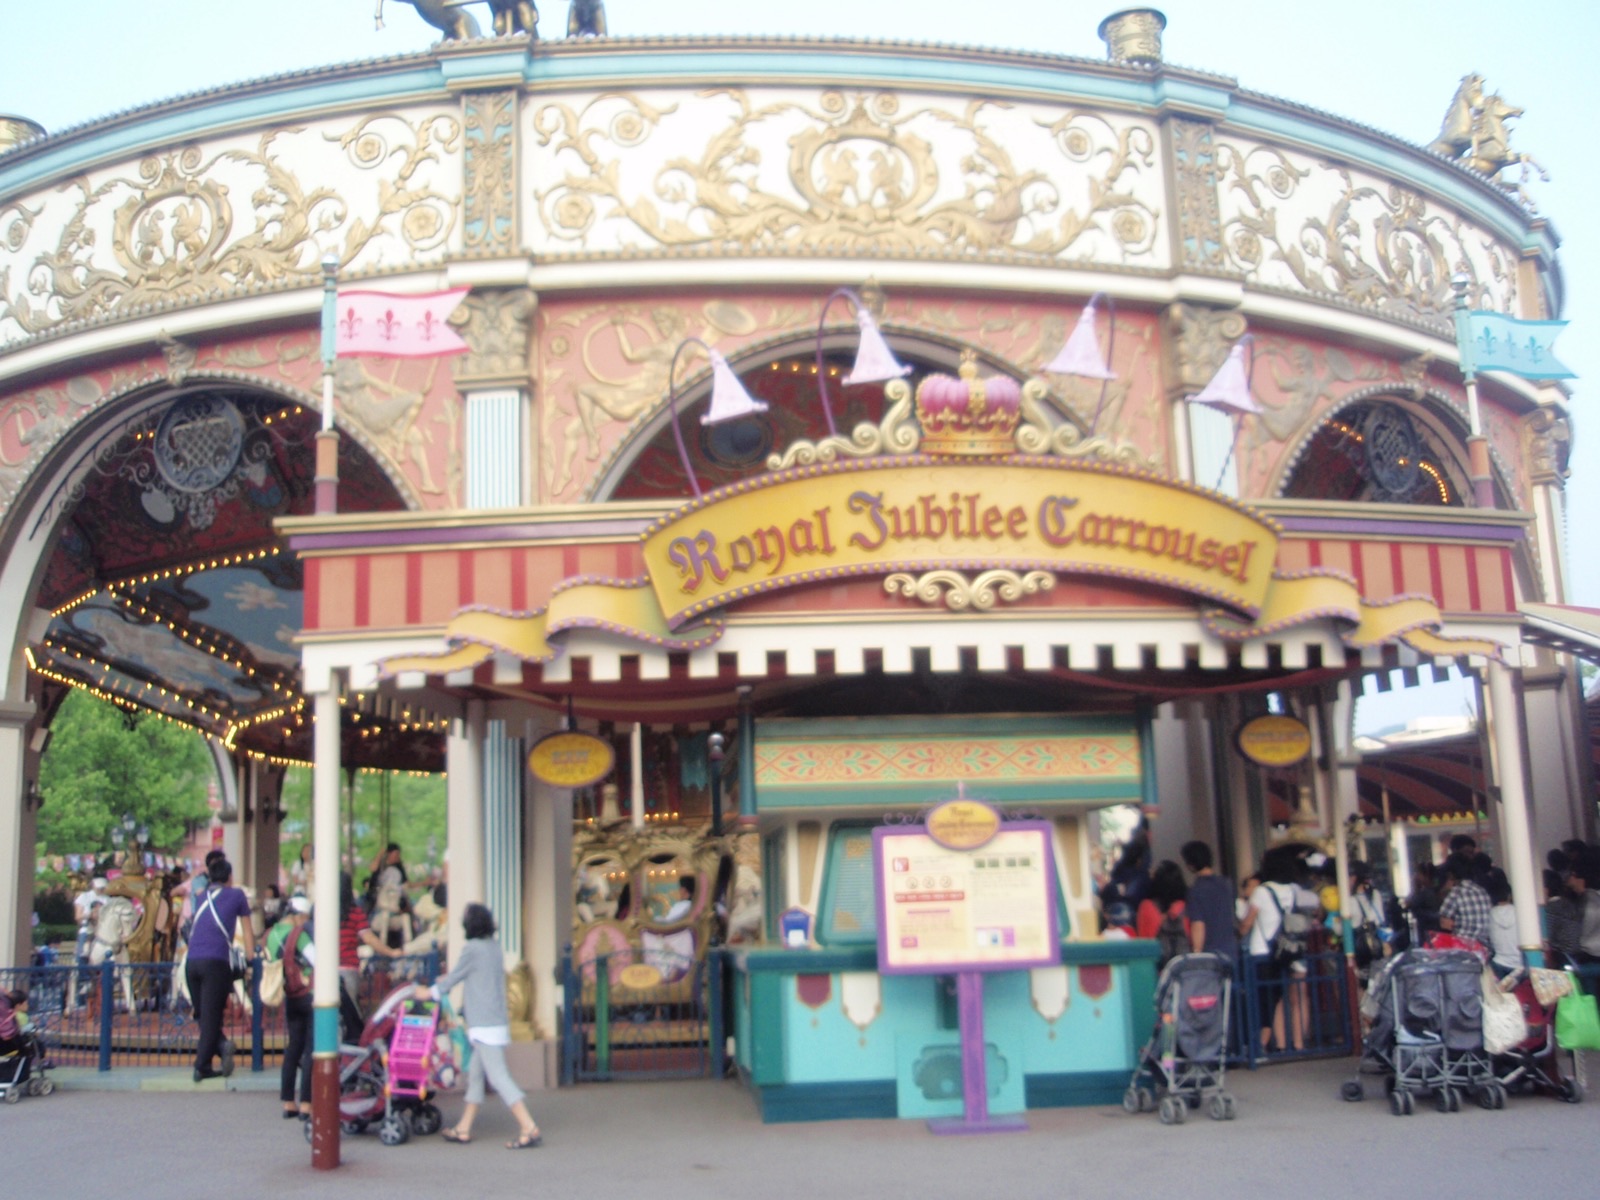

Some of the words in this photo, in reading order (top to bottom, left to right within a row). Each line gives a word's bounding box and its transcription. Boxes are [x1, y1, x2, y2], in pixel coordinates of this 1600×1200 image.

[668, 505, 837, 594] Royal
[847, 490, 1029, 550] Jubilee
[1038, 494, 1258, 583] Carrousel
